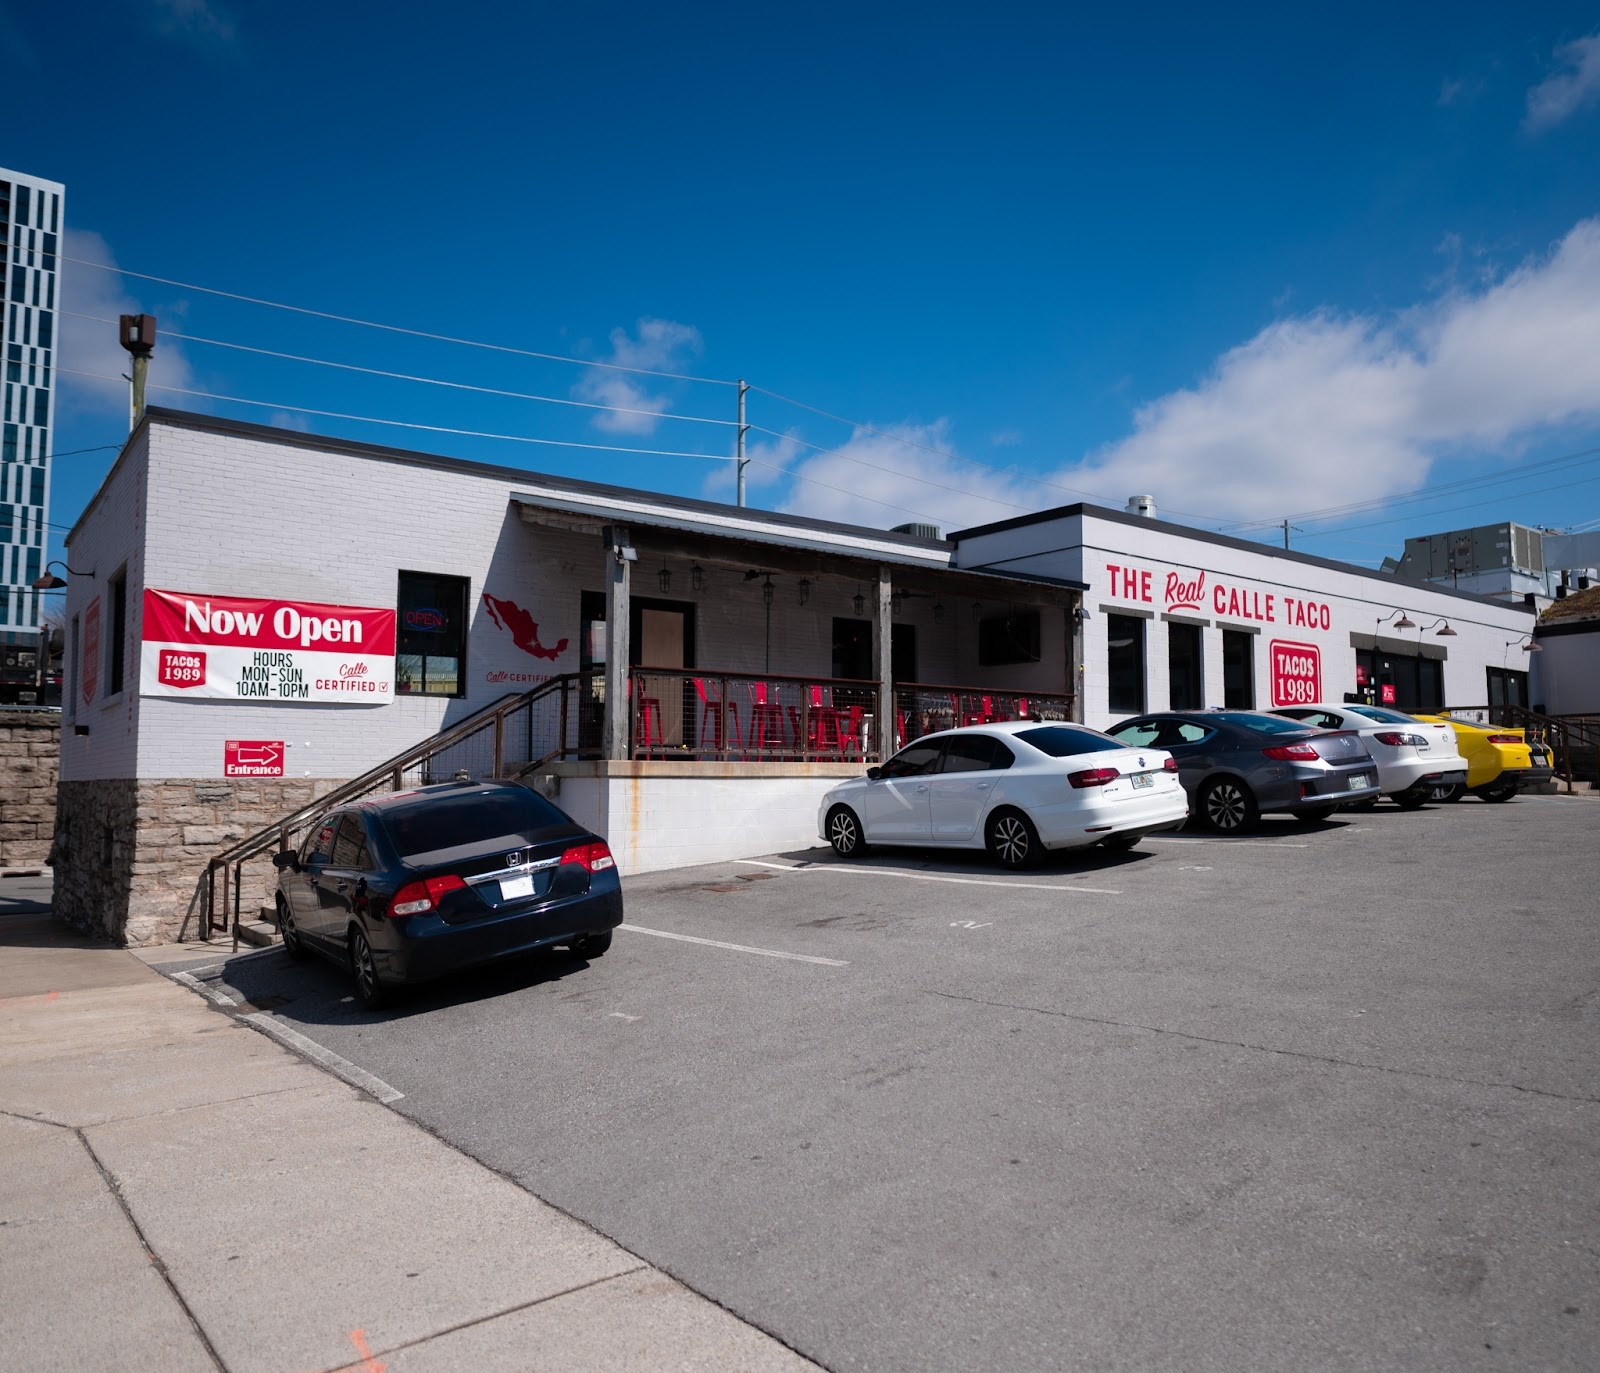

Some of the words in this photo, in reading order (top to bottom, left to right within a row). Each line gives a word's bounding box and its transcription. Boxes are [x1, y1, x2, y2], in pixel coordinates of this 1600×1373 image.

[1106, 564, 1152, 602] THE
[1164, 569, 1205, 604] Real
[1213, 584, 1275, 622] CALLE
[1284, 597, 1330, 631] TACO
[185, 600, 264, 636] Now
[273, 607, 362, 647] Open
[405, 611, 441, 626] OPEN
[165, 655, 201, 667] TACOS
[253, 651, 293, 668] HOURS
[1277, 653, 1314, 677] TACOS
[164, 667, 201, 681] 1989
[242, 666, 303, 683] MON-SUN
[339, 662, 368, 677] Calle
[236, 681, 309, 698] 10AM-10PM
[315, 679, 375, 692] CERTIFIED
[1278, 677, 1315, 703] 1989
[227, 764, 281, 775] Entrance
